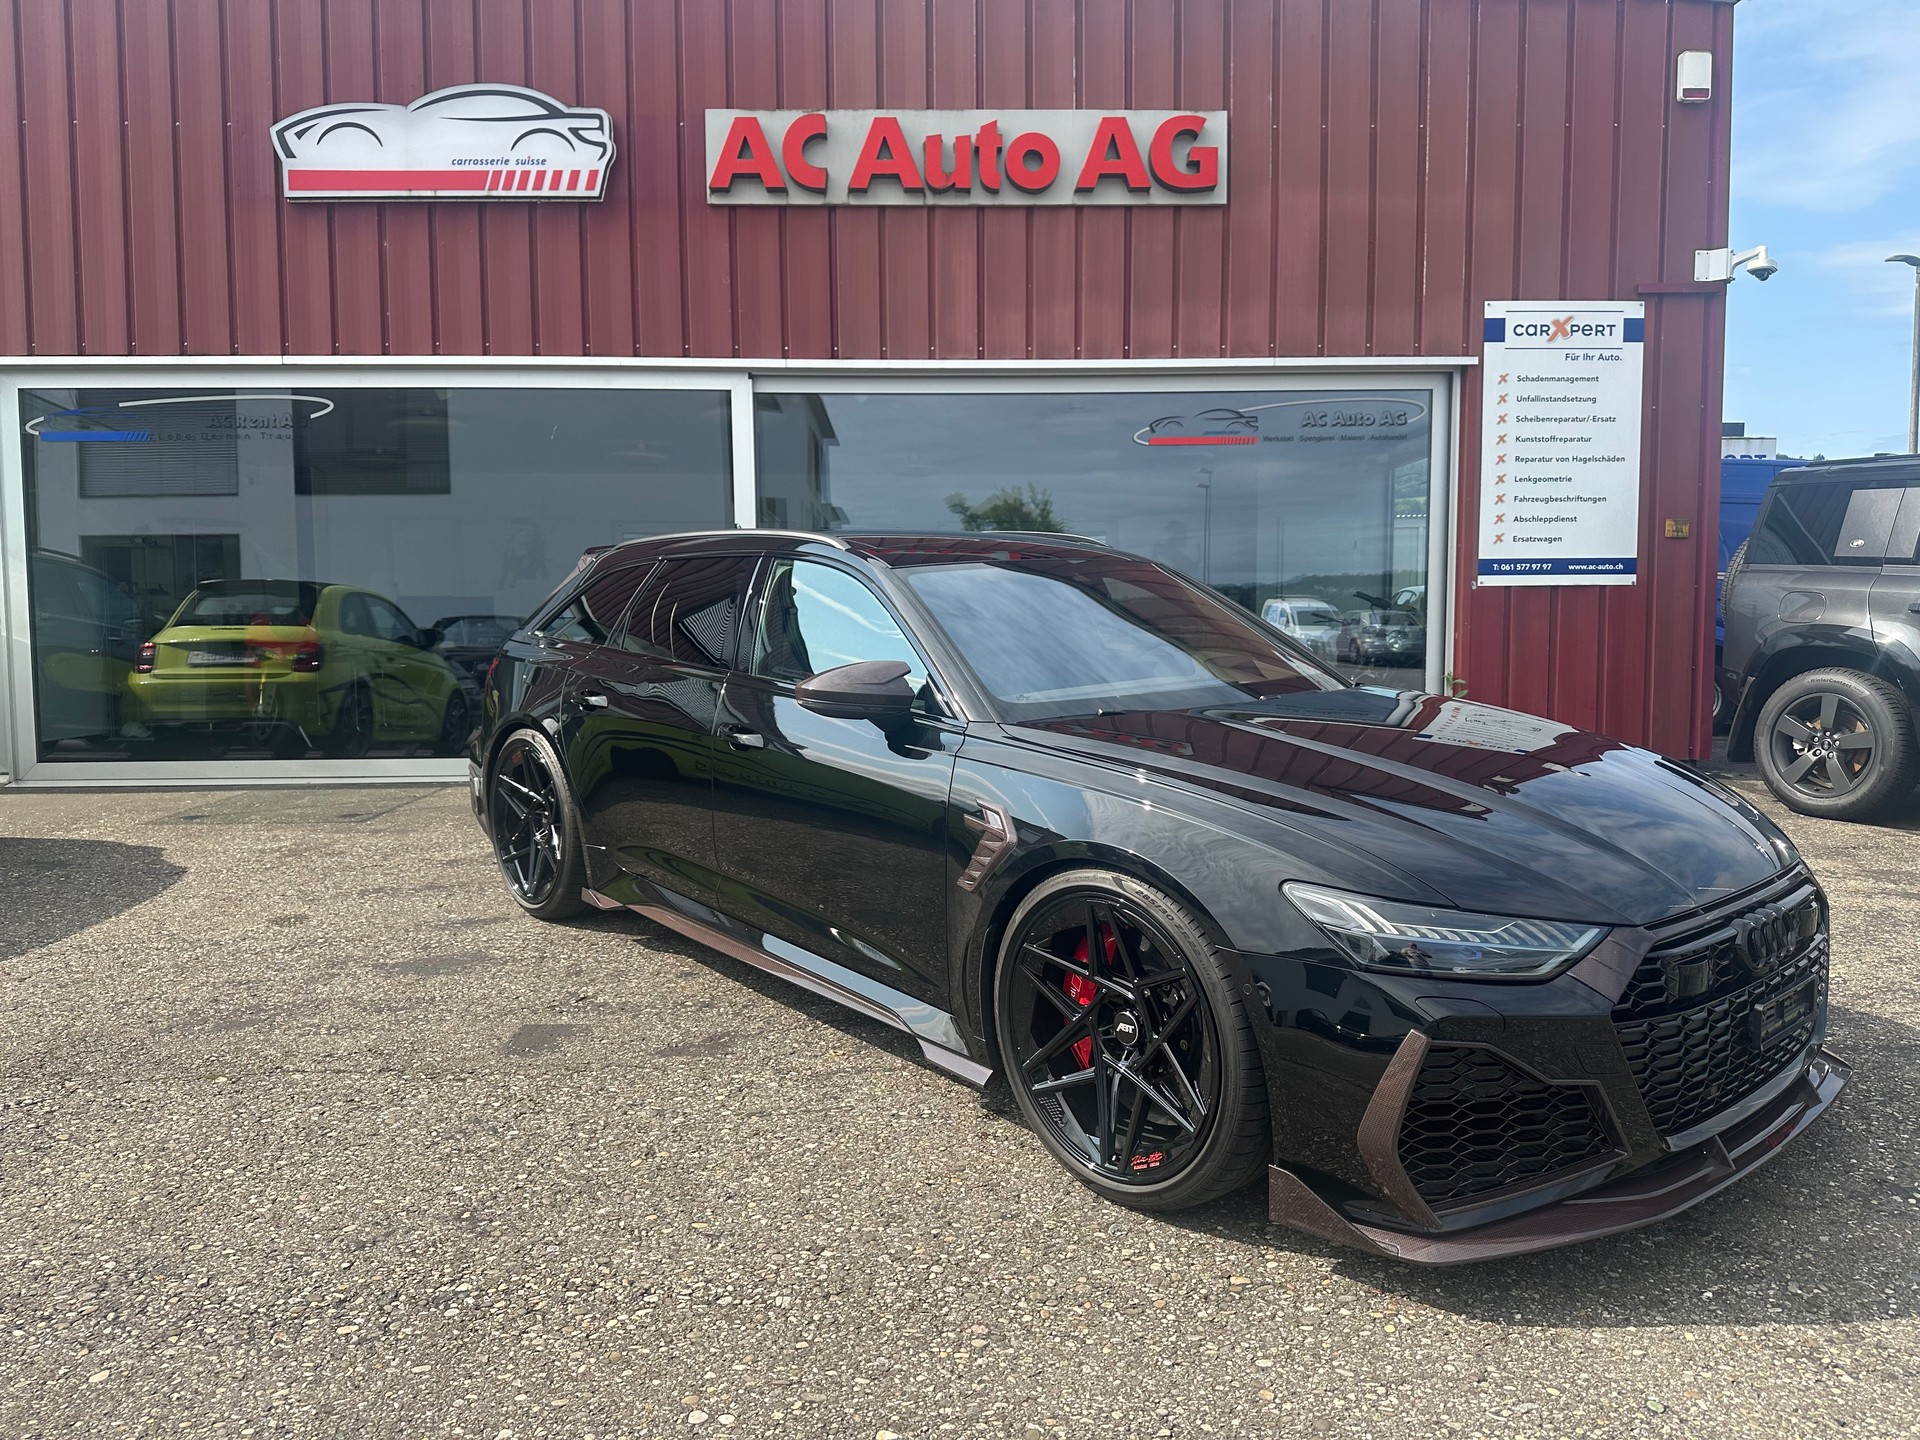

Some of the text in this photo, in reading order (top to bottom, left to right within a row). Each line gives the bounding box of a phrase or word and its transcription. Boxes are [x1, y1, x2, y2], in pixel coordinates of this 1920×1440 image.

[708, 113, 1219, 194] AC Auto AG
[451, 155, 547, 166] carrosserie suisse
[1564, 352, 1623, 361] Für Ihr Auto.
[1516, 374, 1600, 385] Schadenmanagement
[1516, 394, 1597, 405] Unfallinstandsetzung
[1301, 409, 1408, 428] AC Auto AG
[1515, 415, 1617, 425] Scheibenreparatur/-Ersatz
[260, 431, 294, 440] Trau
[1262, 434, 1294, 442] Werkstatt
[1515, 434, 1593, 445] Kunststoffreparatur
[1514, 455, 1554, 465] Reparatur
[1571, 454, 1626, 465] Hagelschäden
[1514, 475, 1573, 485] Lenkgeometrie
[1513, 494, 1607, 505] Fahrzeugbeschriftungen
[1513, 515, 1578, 525] Abschleppdienst
[1512, 535, 1563, 545] Ersatzwagen
[1492, 562, 1624, 571] T: 061 577 97 97 www.ac-auto.ch
[1116, 1022, 1135, 1034] ABT
